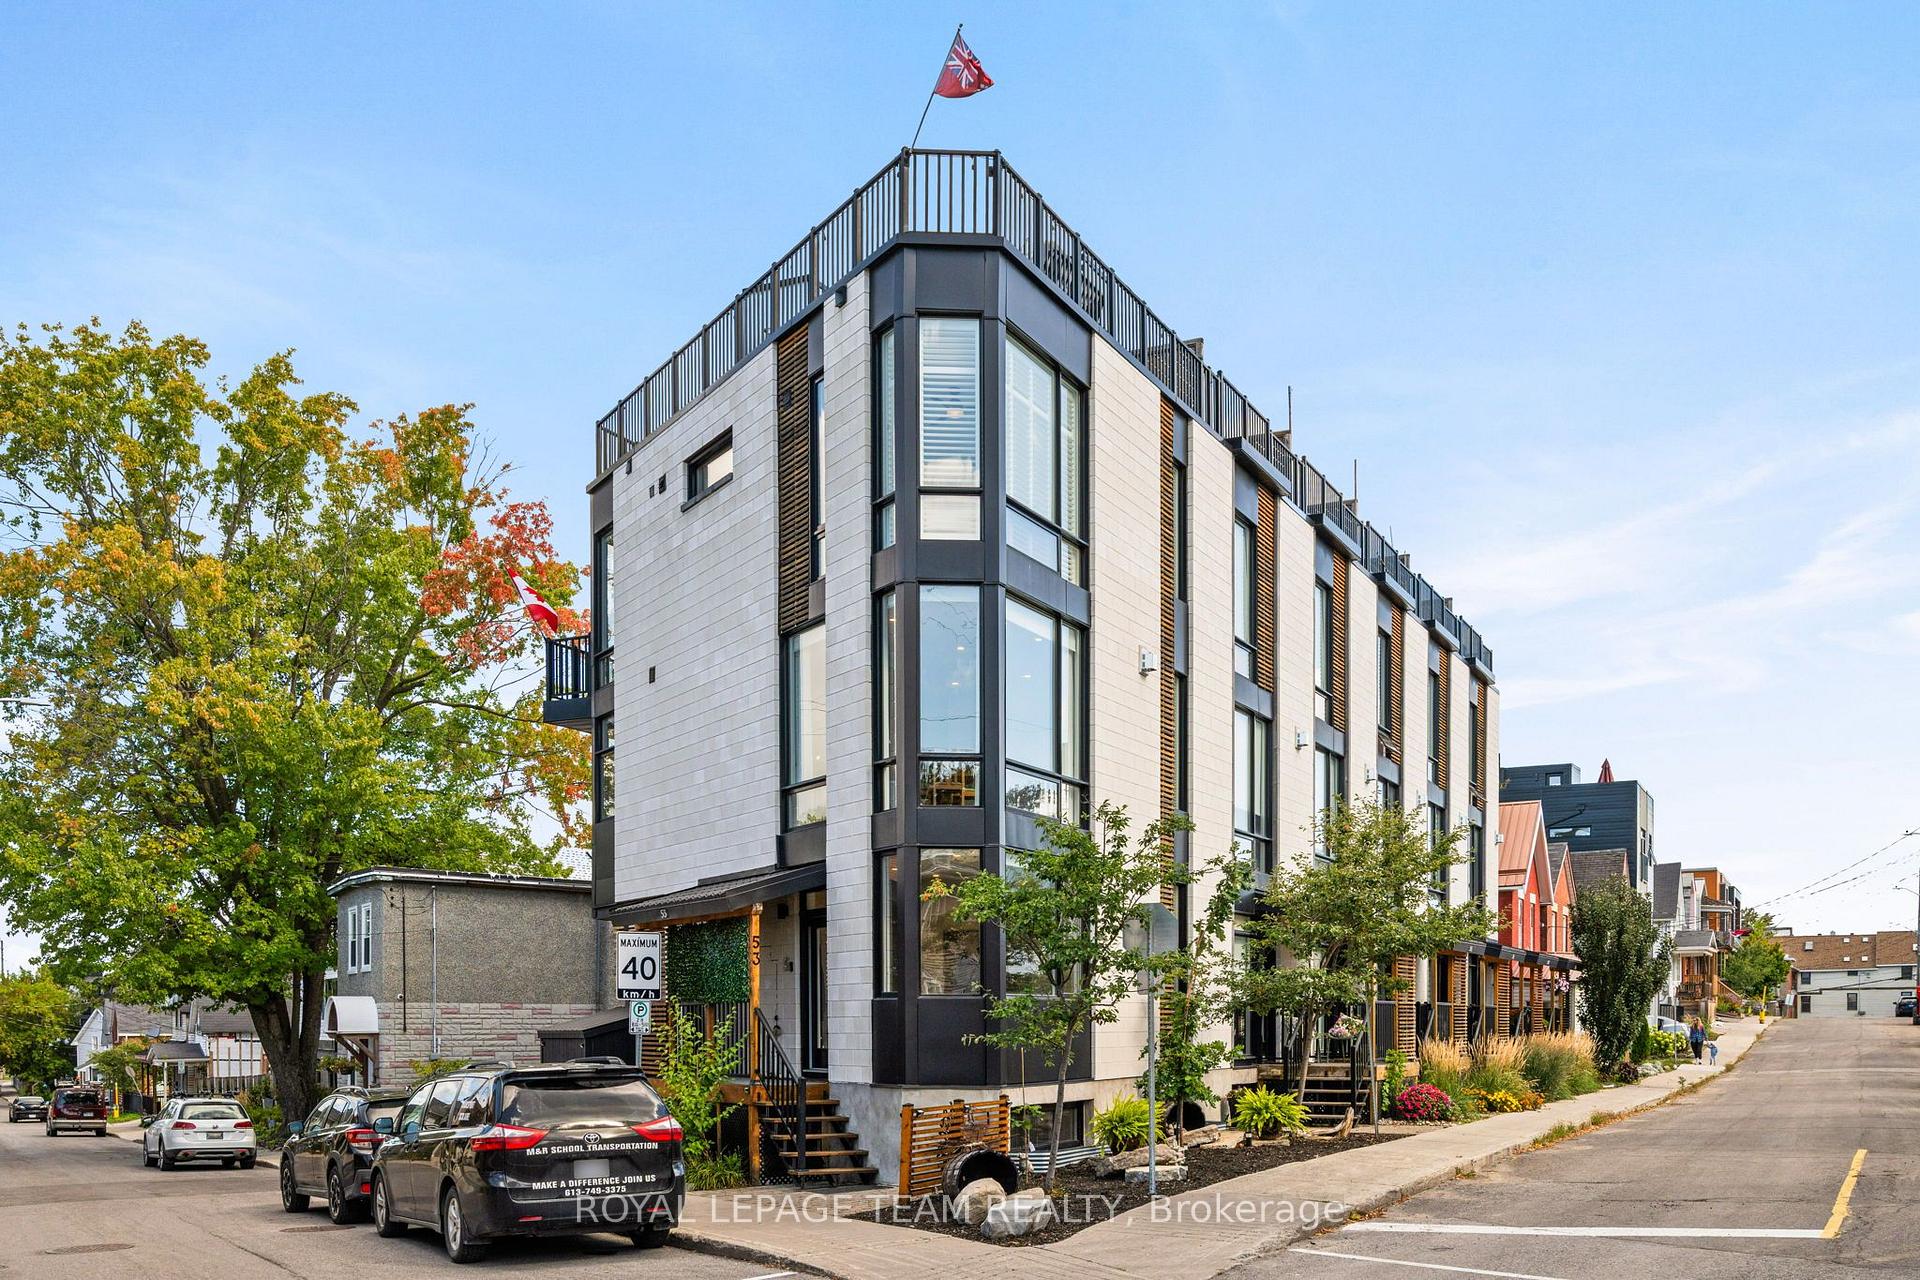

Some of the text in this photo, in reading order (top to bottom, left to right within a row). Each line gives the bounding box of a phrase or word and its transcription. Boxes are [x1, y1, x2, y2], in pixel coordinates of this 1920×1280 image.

[620, 938, 658, 948] MAXIMUM
[622, 956, 656, 980] 40
[622, 990, 655, 998] km/h
[638, 1006, 644, 1014] P
[550, 1146, 584, 1154] SCHOOL
[587, 1142, 658, 1151] TRANSPORTATION
[532, 1182, 558, 1190] MAKE
[568, 1176, 620, 1188] DIFFERENCE
[622, 1176, 642, 1184] JOIN
[564, 1186, 626, 1196] 613-749-3375
